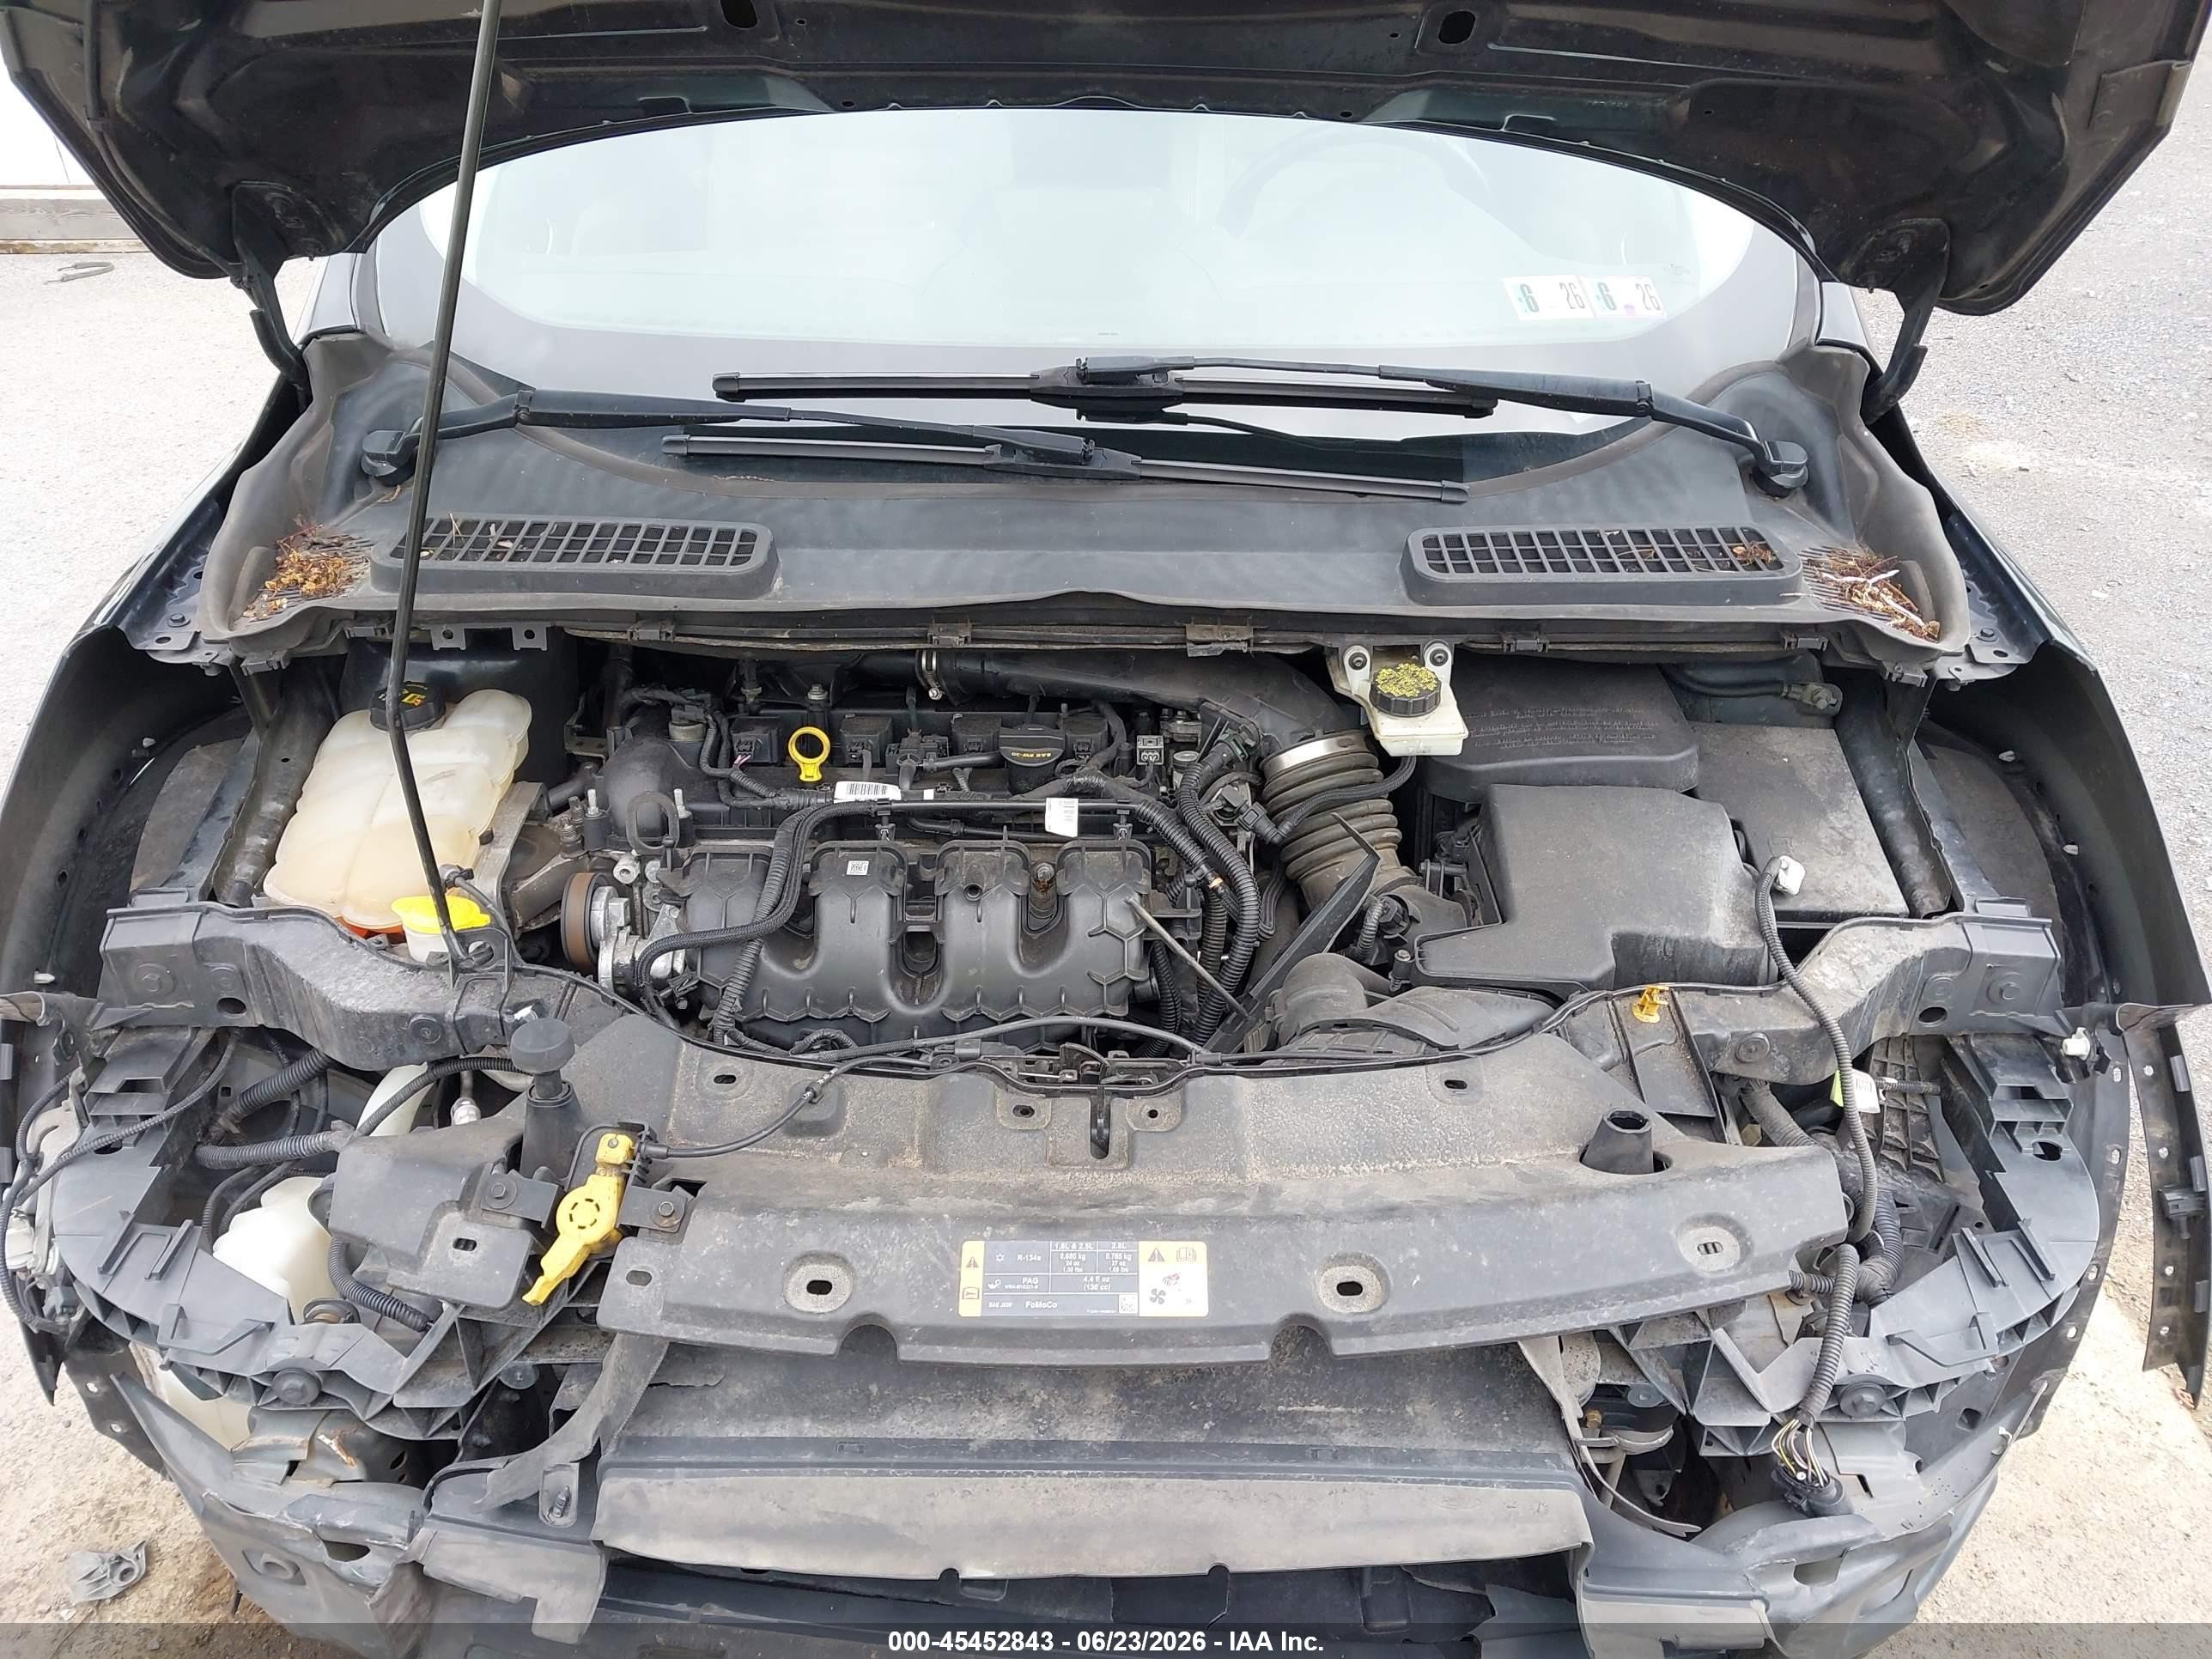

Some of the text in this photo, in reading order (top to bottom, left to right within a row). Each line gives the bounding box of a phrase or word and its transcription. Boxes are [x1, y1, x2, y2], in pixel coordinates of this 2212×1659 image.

[1519, 283, 1585, 313] 6 26
[1597, 282, 1662, 311] 6 26
[1078, 1252, 1086, 1261] kg
[1123, 1252, 1132, 1261] kg
[1084, 1283, 1111, 1291] (130 cc)
[1025, 1300, 1058, 1309] FoMoCo
